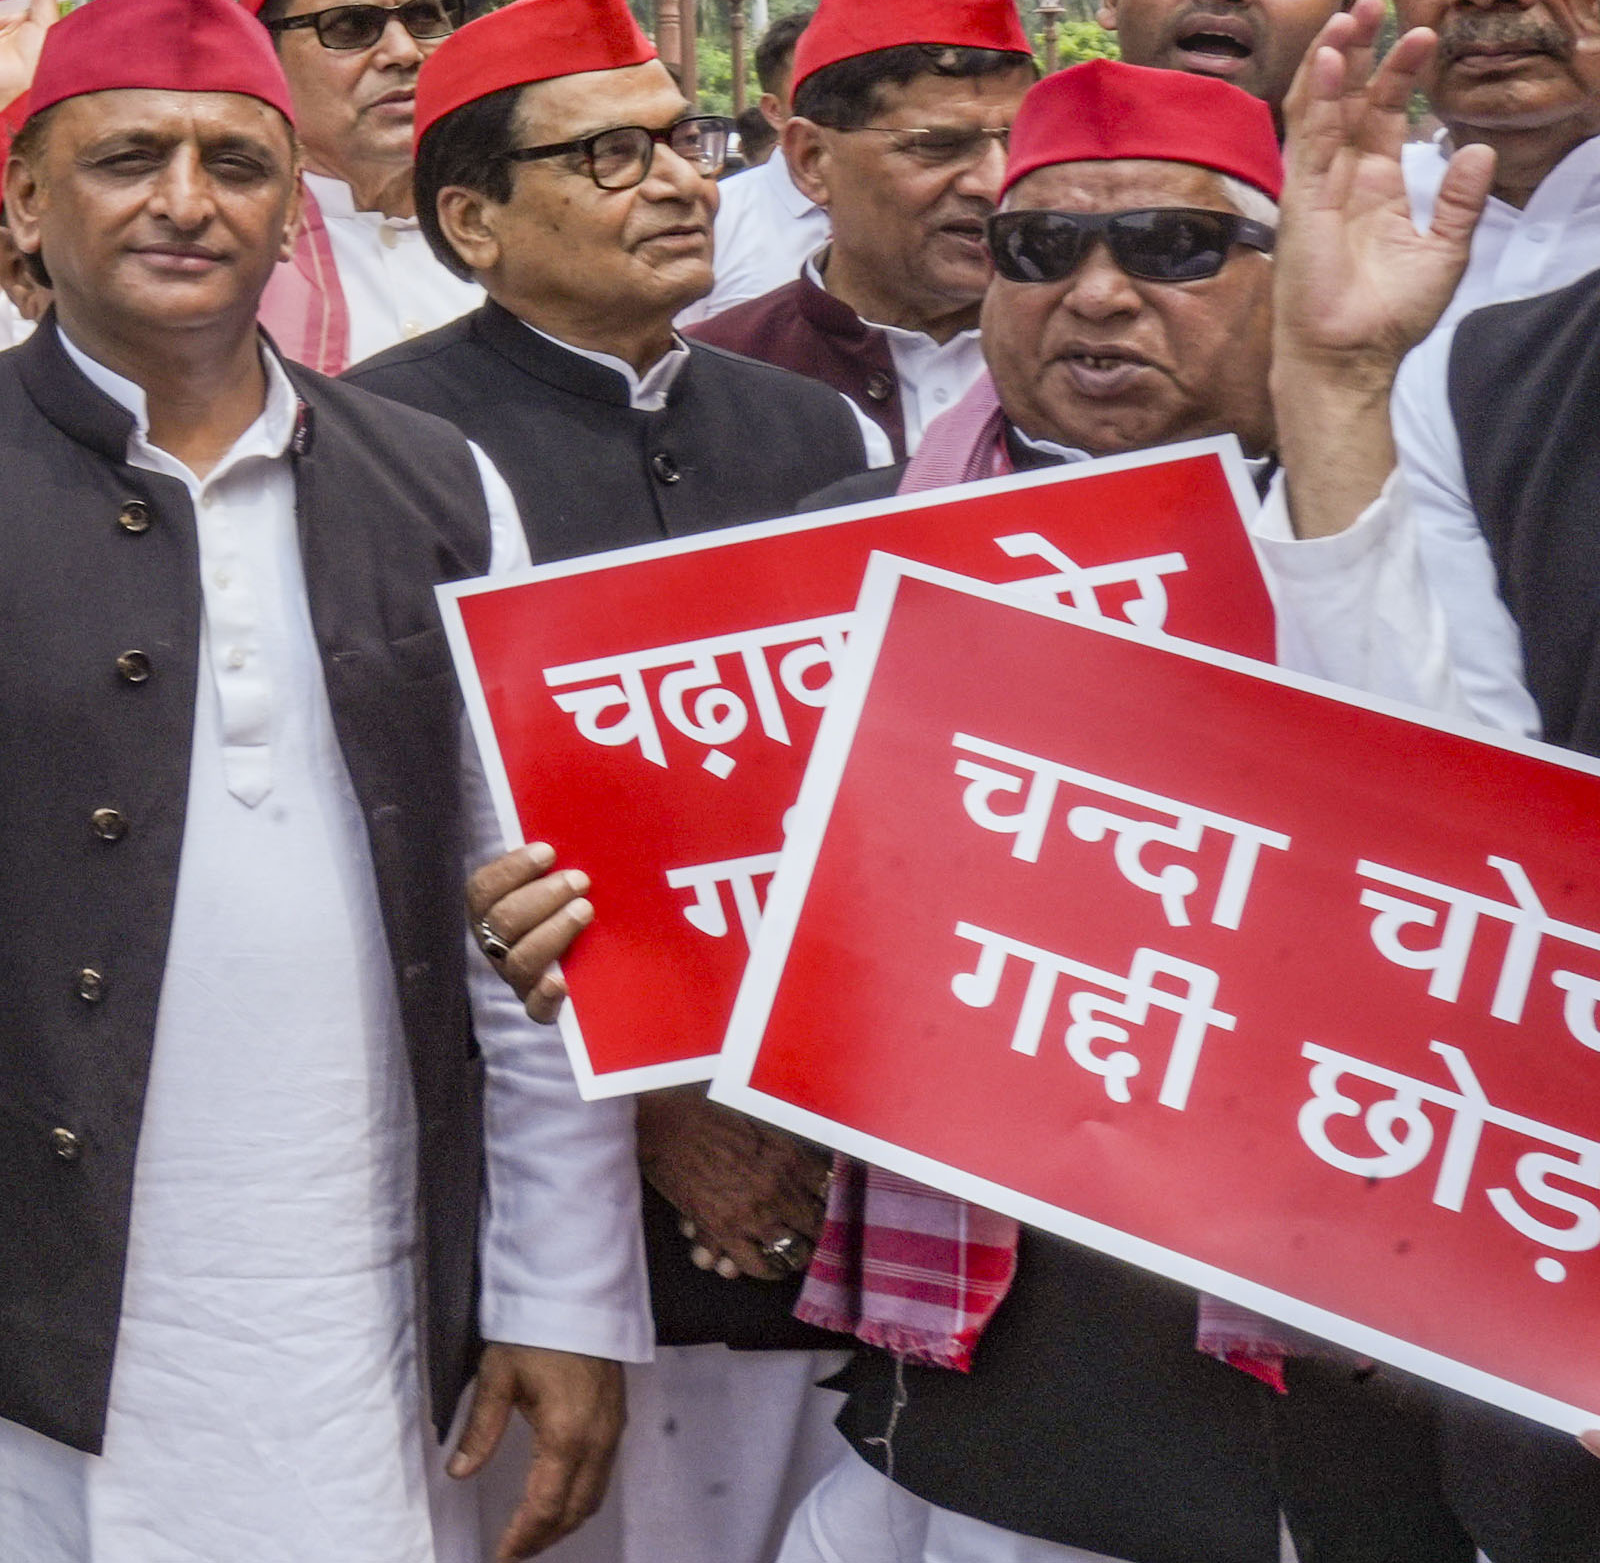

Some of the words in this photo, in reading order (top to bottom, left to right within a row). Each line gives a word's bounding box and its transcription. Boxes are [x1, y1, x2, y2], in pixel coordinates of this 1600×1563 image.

[543, 611, 857, 780] चढ़ाव
[952, 732, 1291, 929] चन्दा
[950, 920, 1238, 1111] गद्दी
[1297, 1039, 1600, 1283] छोड़
